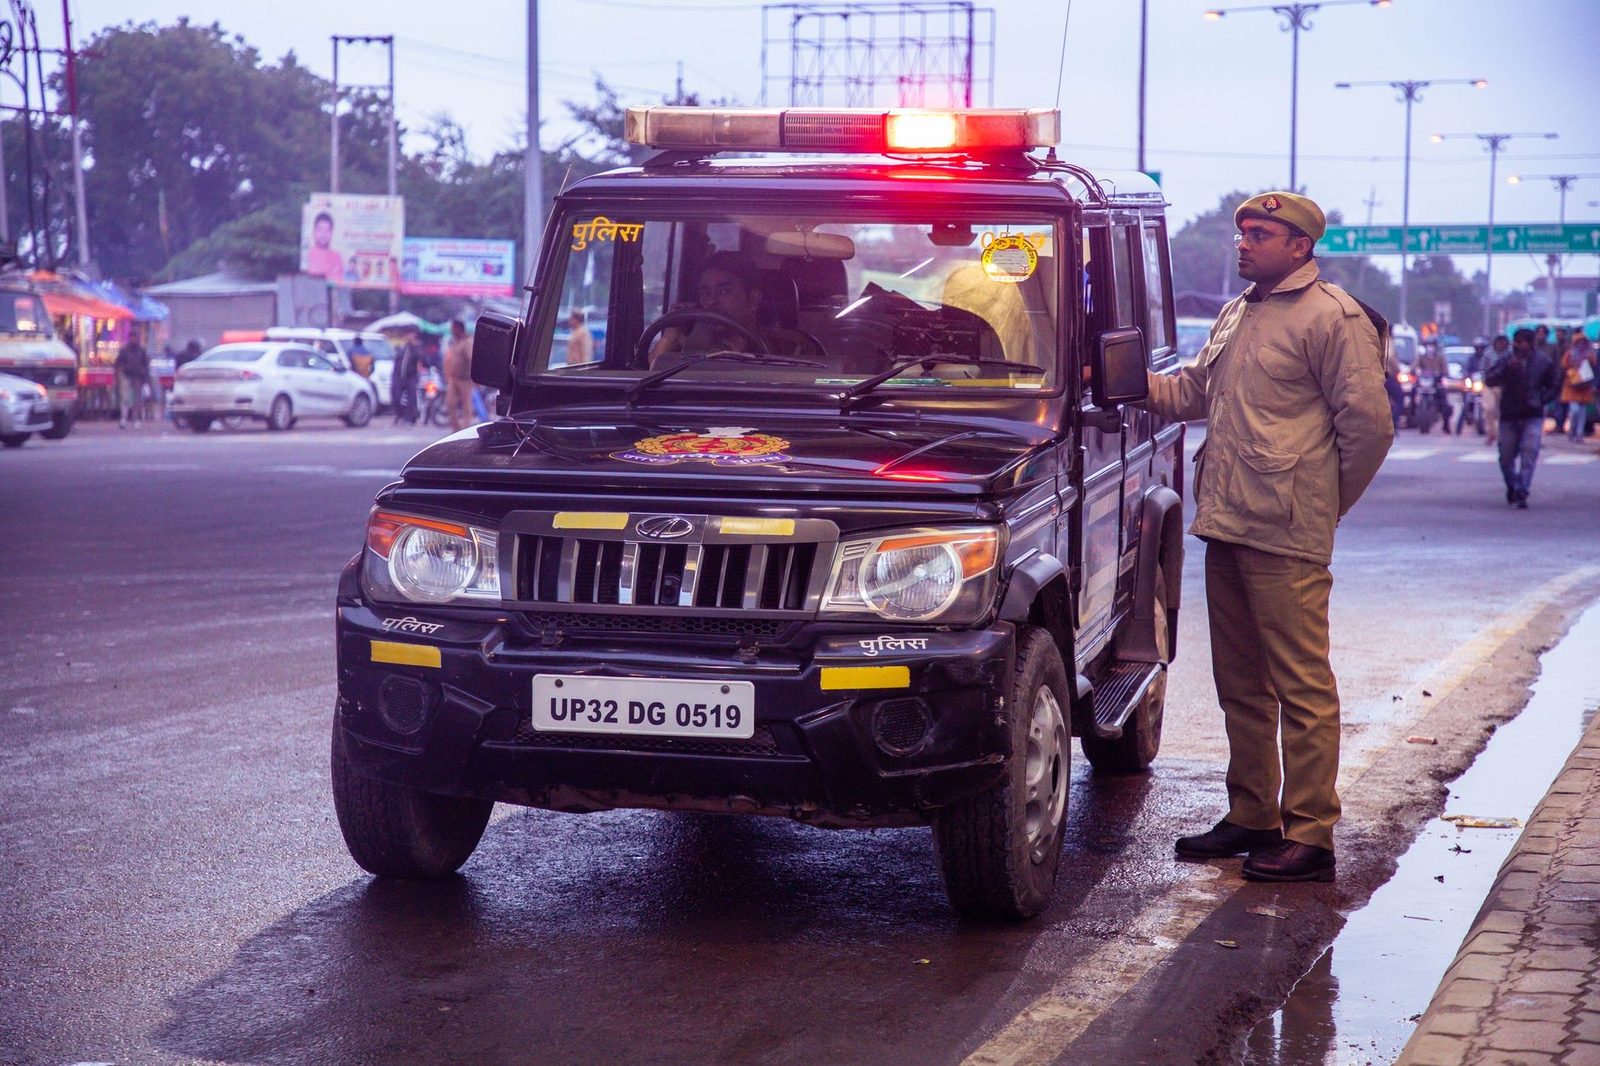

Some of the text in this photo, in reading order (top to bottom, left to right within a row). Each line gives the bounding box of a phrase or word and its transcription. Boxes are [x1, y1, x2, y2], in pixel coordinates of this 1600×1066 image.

[571, 216, 644, 251] पुलिस
[382, 616, 445, 634] पुलिस
[859, 635, 929, 657] पुलिस
[550, 697, 741, 729] UP32 DG 0519
